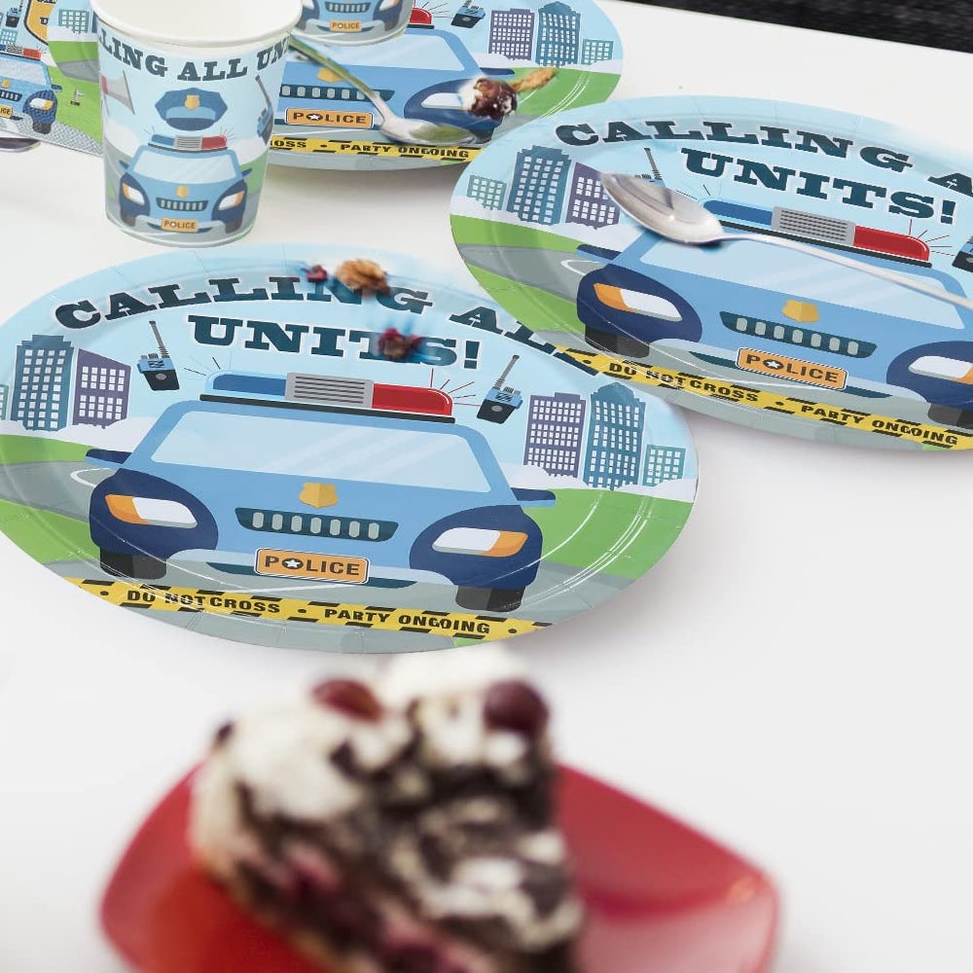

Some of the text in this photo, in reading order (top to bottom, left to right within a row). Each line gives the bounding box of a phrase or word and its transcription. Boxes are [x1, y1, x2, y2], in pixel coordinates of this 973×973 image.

[331, 22, 360, 30] POLICE
[99, 27, 168, 78] LING
[177, 58, 248, 81] ALL
[292, 112, 367, 125] POLICE
[340, 143, 392, 153] PARTY
[555, 120, 914, 173] CALLING
[680, 147, 957, 225] UNITS!
[163, 220, 196, 230] POLICE
[745, 353, 839, 384] POLICE
[609, 362, 637, 376] DO
[689, 380, 760, 403] CROSS
[801, 405, 864, 425] PARTY
[872, 419, 959, 446] ONGOING
[264, 555, 360, 577] POLICE
[127, 589, 156, 603] DO
[209, 597, 281, 614] CROSS
[324, 607, 391, 624] PARTY
[398, 614, 490, 635] ONGOING
